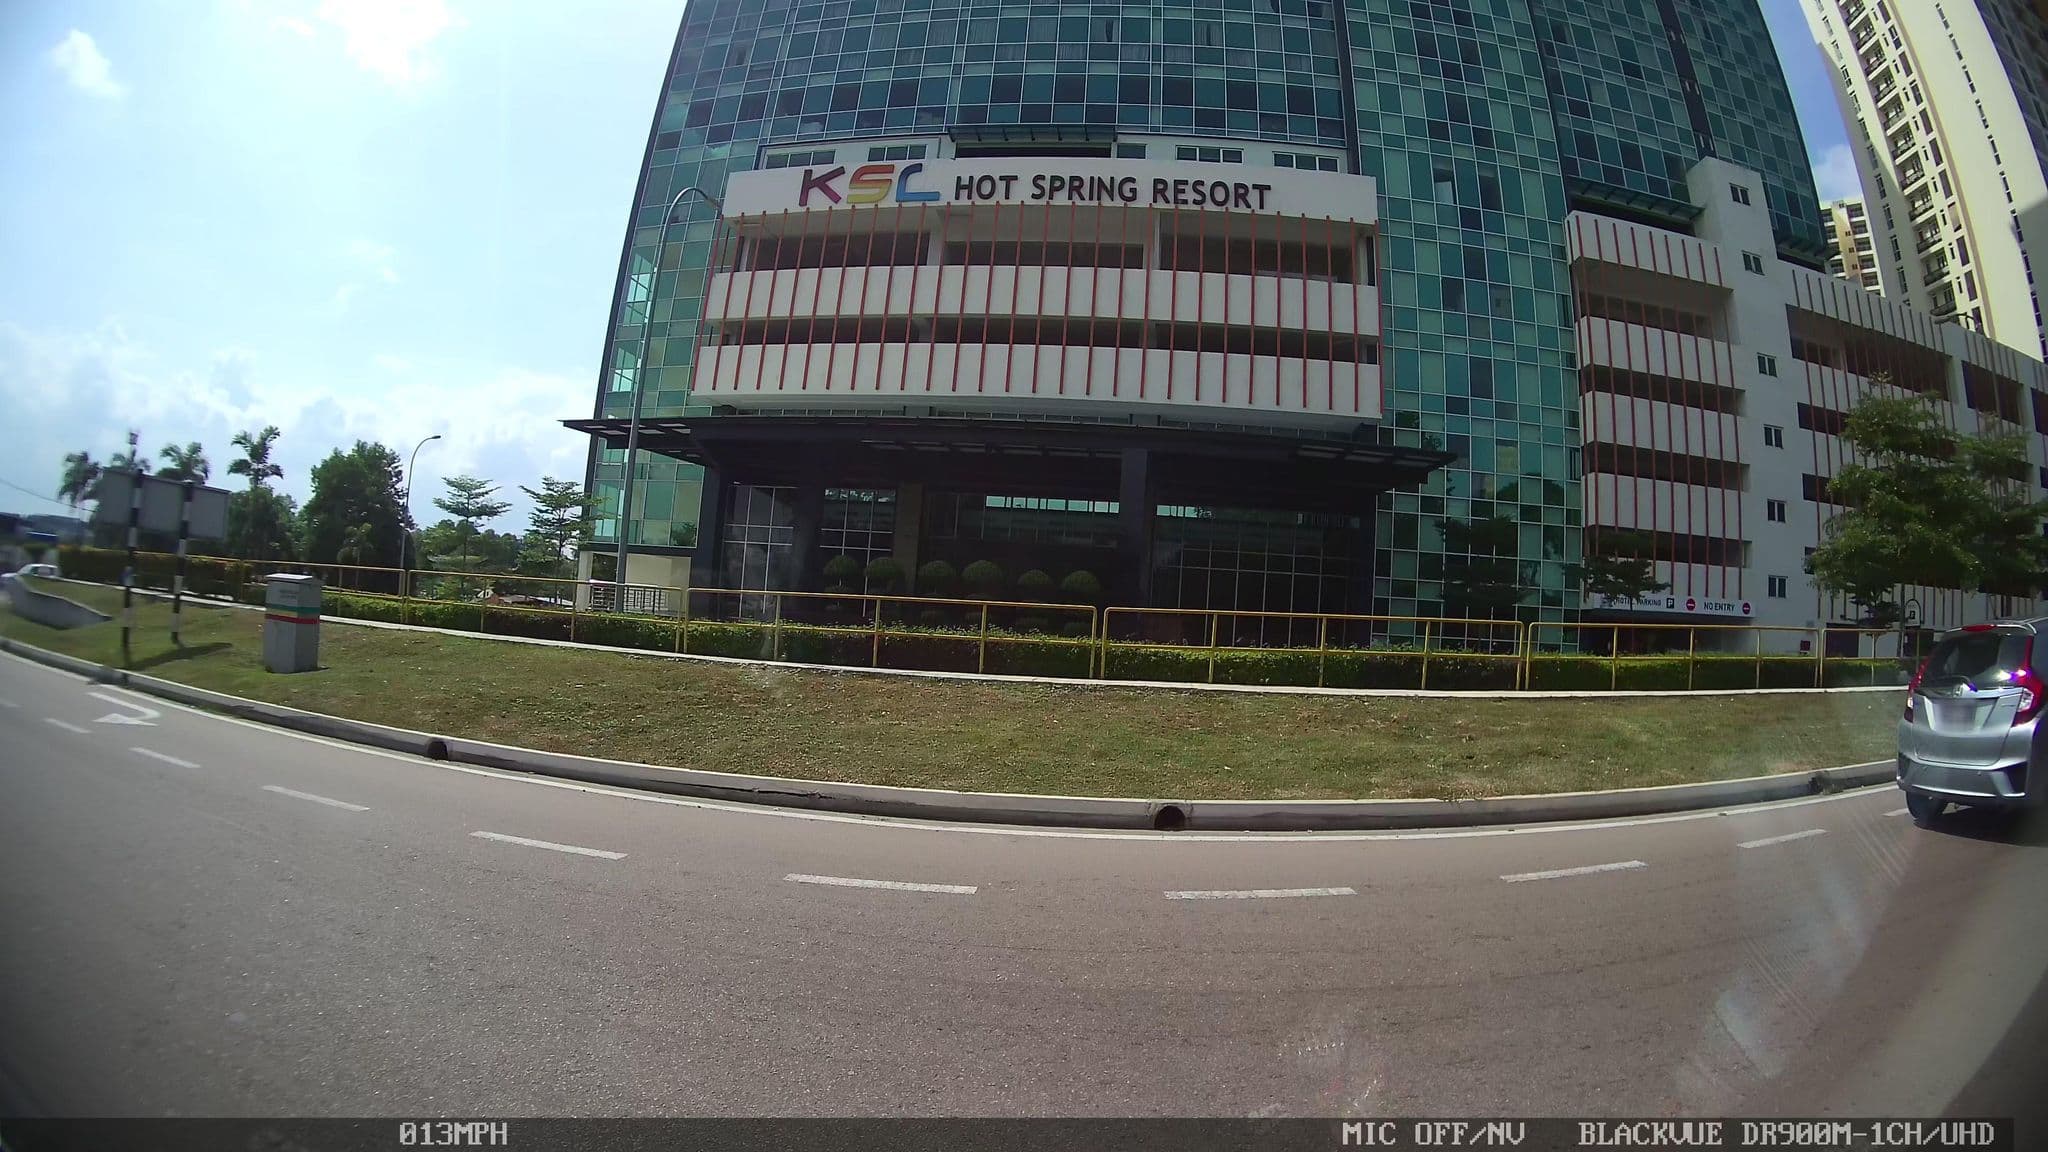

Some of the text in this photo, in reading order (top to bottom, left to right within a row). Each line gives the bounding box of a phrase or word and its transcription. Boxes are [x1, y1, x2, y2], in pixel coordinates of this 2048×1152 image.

[954, 175, 1018, 200] HOT
[1031, 175, 1137, 202] SPRING
[1152, 178, 1272, 209] RESORT
[1704, 602, 1736, 612] NO ENTRY
